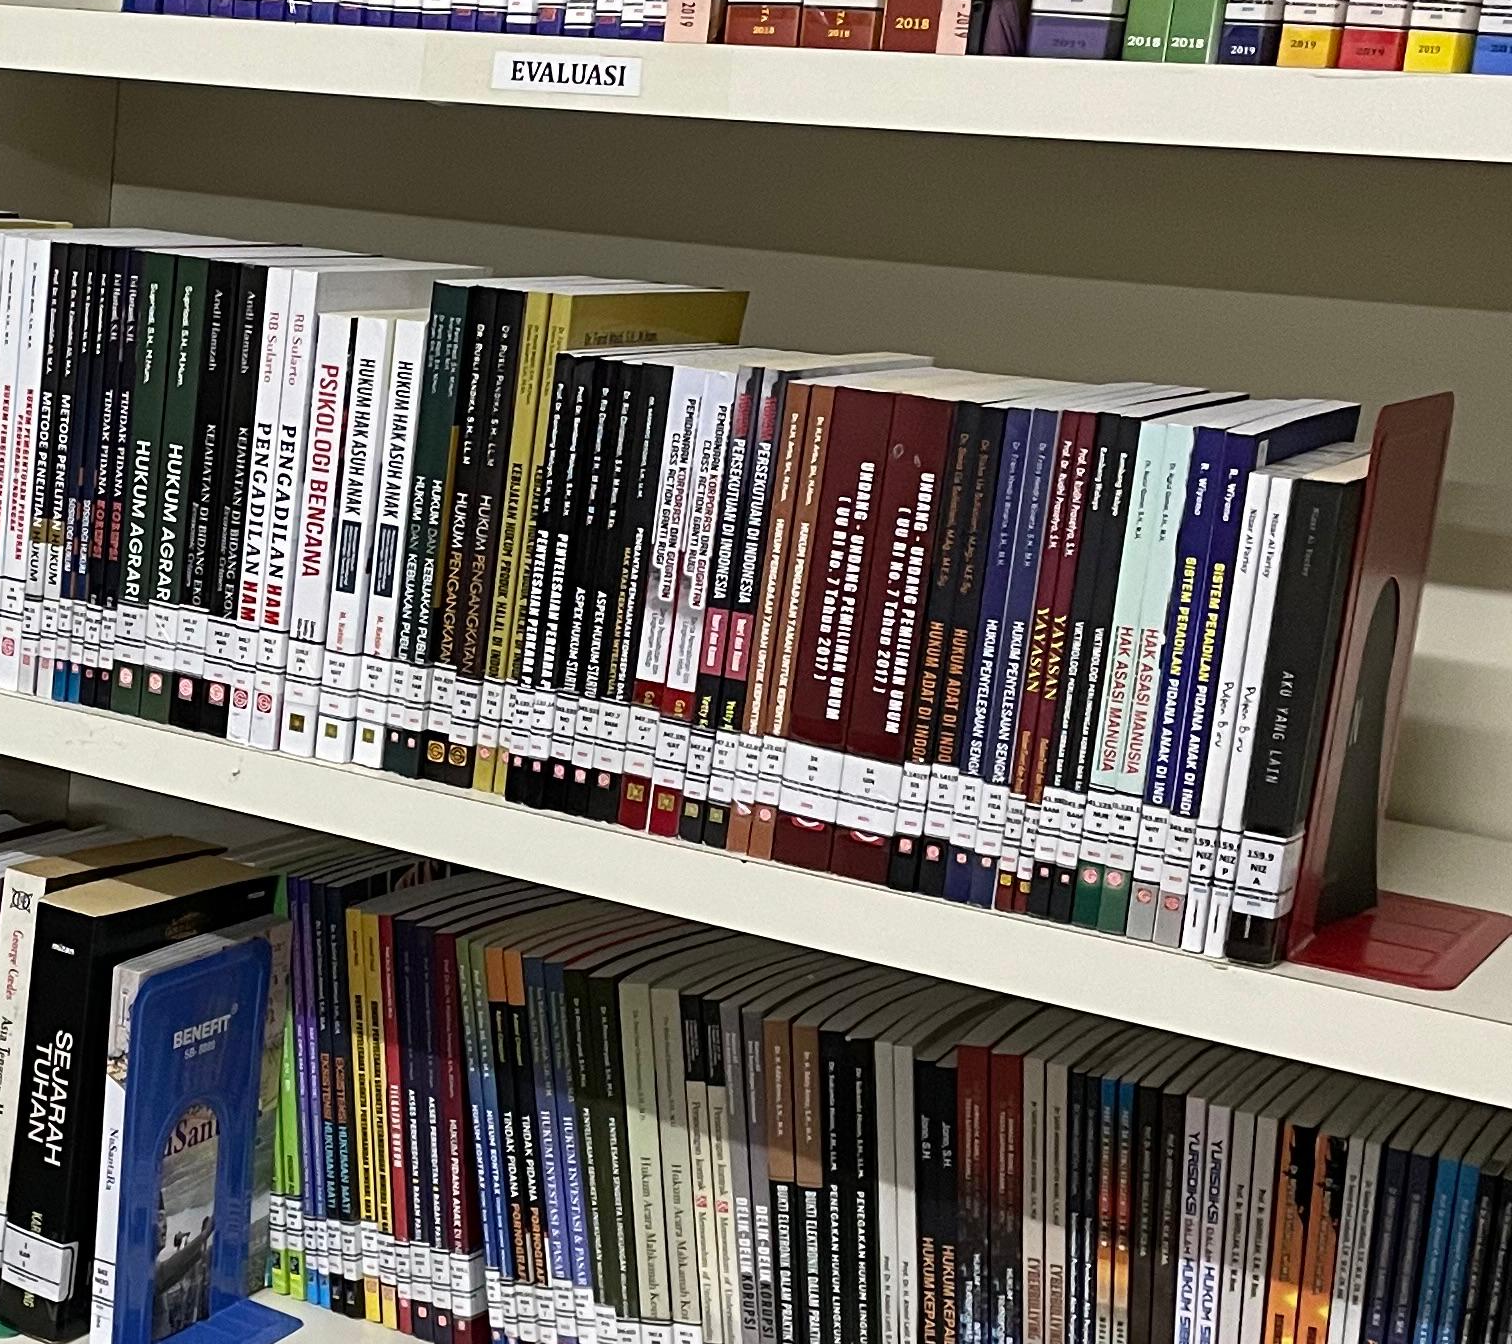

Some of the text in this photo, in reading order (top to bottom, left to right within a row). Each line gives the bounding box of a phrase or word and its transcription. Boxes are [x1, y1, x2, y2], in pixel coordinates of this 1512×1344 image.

[895, 18, 930, 30] 2018
[1126, 36, 1161, 48] 2018
[1170, 36, 1204, 48] 2018
[1230, 45, 1256, 55] 2019
[510, 60, 627, 88] EVALUASI
[131, 441, 150, 519] HUKUM
[302, 364, 339, 576] PSIKOLOGI BENCANA
[383, 361, 413, 518] HUKUM HAK ASUH ANAK
[163, 444, 183, 522] HUKUM
[240, 423, 272, 621] PENGADILAN HAM
[264, 425, 296, 625] PENGADILAN HAM
[738, 443, 771, 603] PERSEKUTUAN DI INDONESIA
[462, 495, 492, 673] HUKUM PENGANGKATAN
[543, 534, 568, 677] PENYELESAIAN PERKARA
[825, 462, 874, 720] UNDANG UNDANG PEMILIHAN UMUM
[885, 473, 934, 733] UNDANG UNDANG PEMILIHAN UMUM
[1180, 557, 1197, 602] SISTEM
[1044, 615, 1066, 700] YAYASAN
[1170, 607, 1190, 675] PERADILAN
[1184, 563, 1225, 785] SISTEM PERADILAN PIDANA ANAK DI
[1126, 629, 1159, 774] HAK ASASI MANUSIA
[1163, 679, 1181, 725] PIDANA
[1265, 671, 1294, 784] AKU YANG LAIN
[1156, 765, 1170, 778] DI
[1158, 728, 1174, 762] ANAK
[172, 1012, 231, 1050] BENEFIT
[27, 1042, 53, 1143] TUHAN
[43, 1029, 73, 1166] SEJARAH
[522, 1115, 538, 1201] TINDAK PIDANA
[671, 1164, 689, 1298] Hukum Acara Mahkamah
[857, 1191, 866, 1258] PENEGAKAN
[858, 1261, 867, 1300] HUKUM
[942, 1245, 955, 1297] HUKUM
